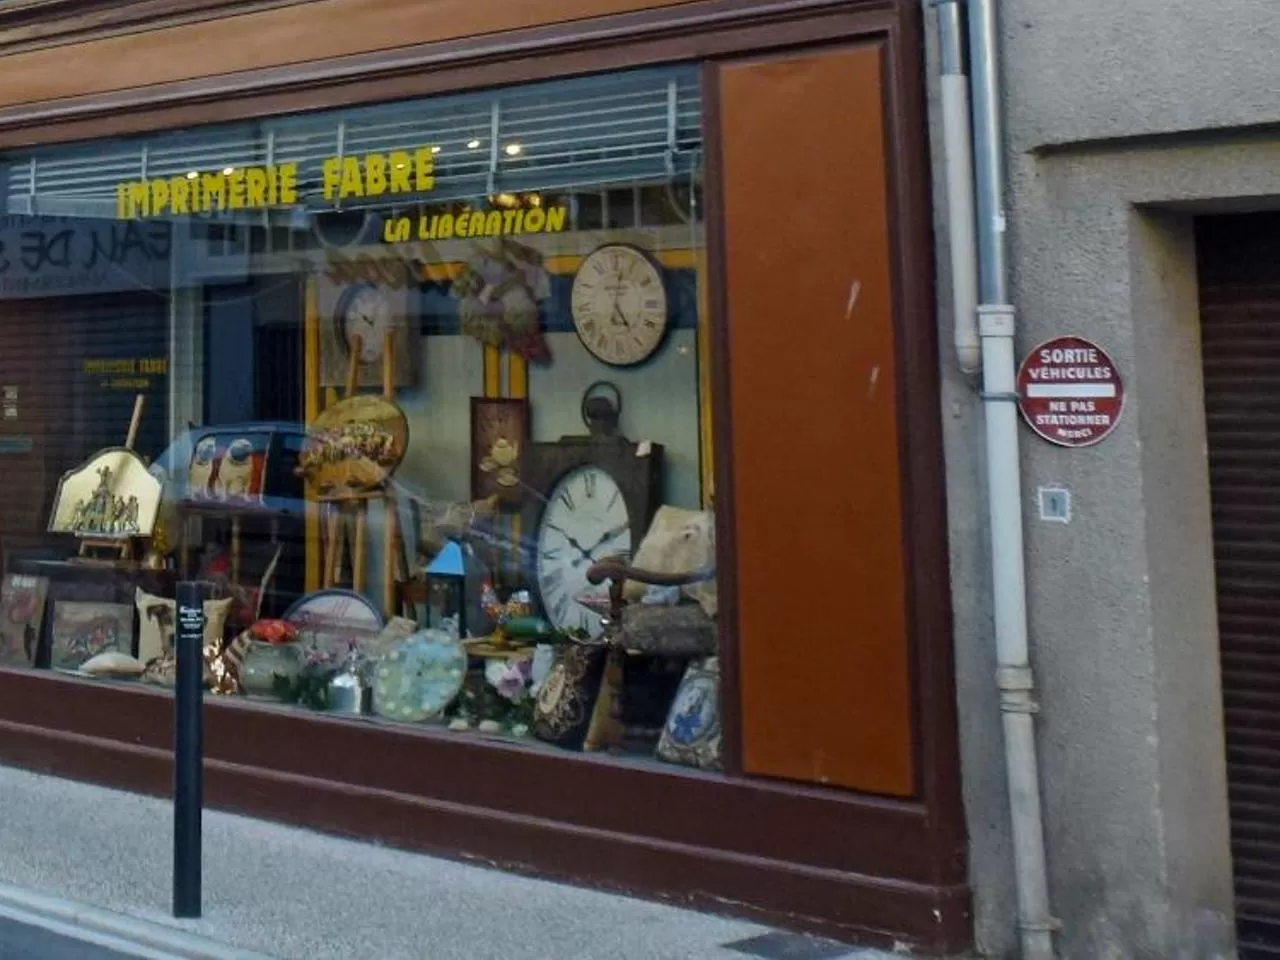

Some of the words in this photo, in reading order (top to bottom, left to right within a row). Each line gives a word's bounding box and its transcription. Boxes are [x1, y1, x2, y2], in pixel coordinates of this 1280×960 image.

[116, 163, 297, 220] IMPRIMERIE
[323, 147, 436, 200] FABRE
[384, 217, 411, 242] LA
[1040, 348, 1098, 364] SORTIE
[1049, 401, 1067, 412] NE
[1070, 401, 1096, 412] PAS
[1035, 415, 1110, 426] STATIONNER
